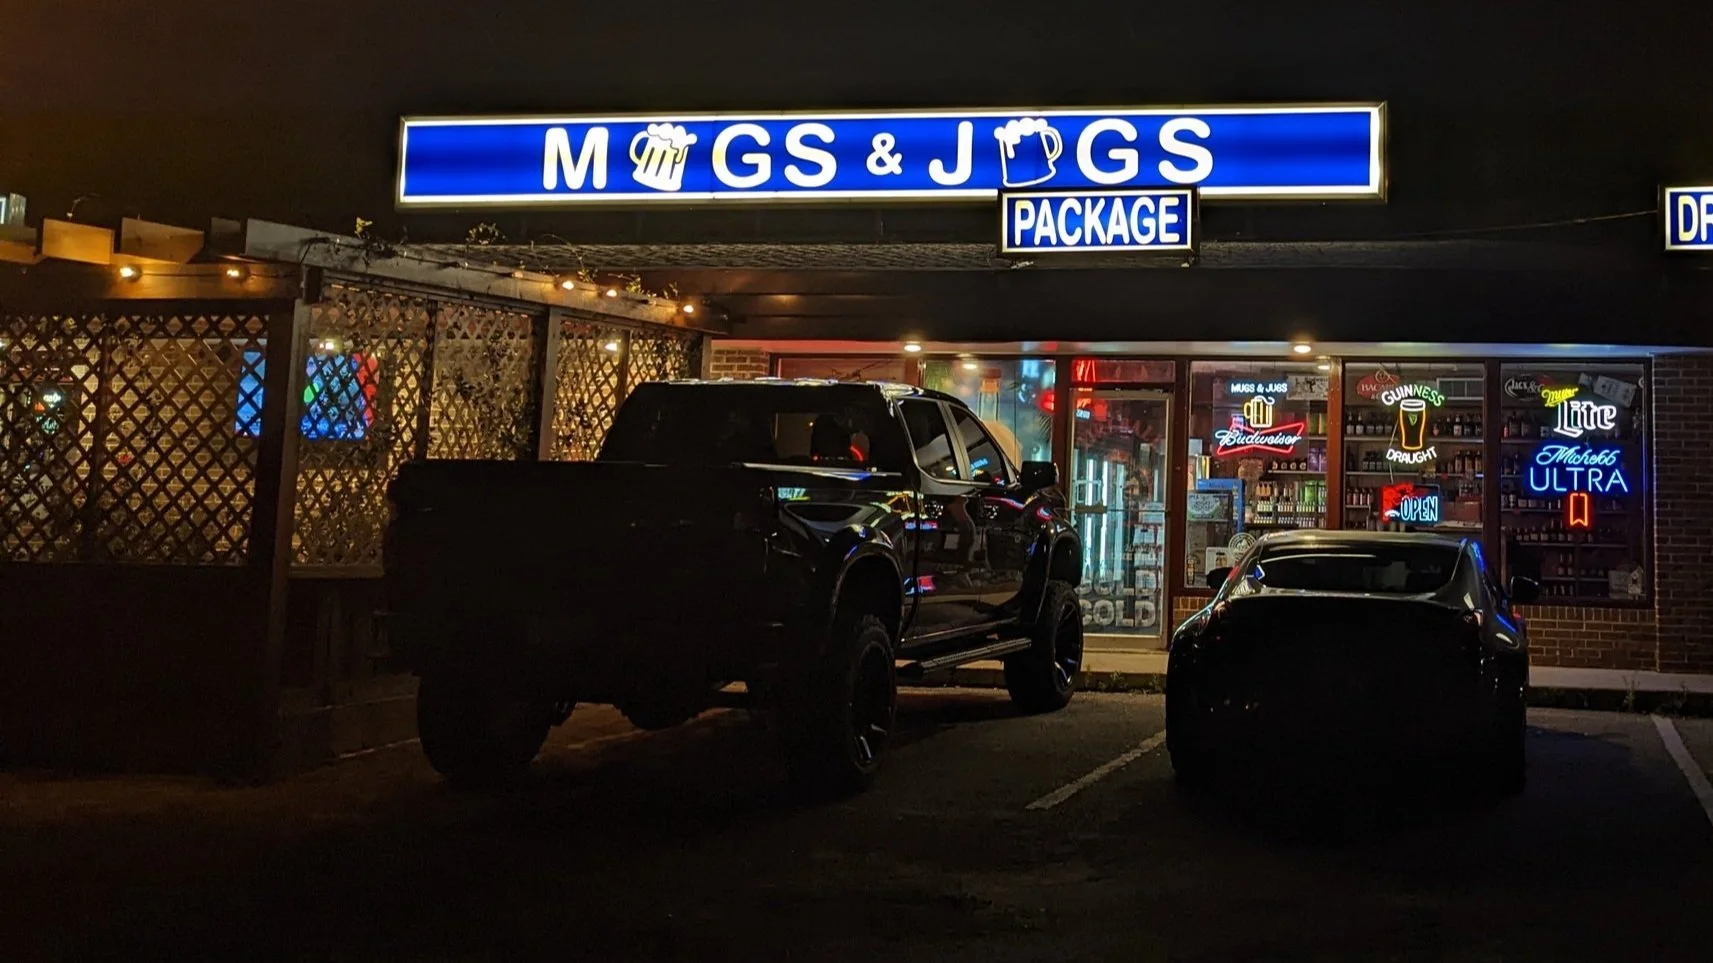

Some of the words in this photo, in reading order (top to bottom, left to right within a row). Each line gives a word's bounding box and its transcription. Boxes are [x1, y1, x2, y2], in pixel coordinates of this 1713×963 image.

[866, 132, 902, 176] &
[1014, 197, 1181, 246] PACKAGE
[1231, 383, 1255, 393] MUGS
[1256, 383, 1264, 393] &
[1265, 383, 1288, 393] JUGS
[1381, 384, 1445, 407] GUINNESS
[1553, 400, 1617, 438] Lite
[1215, 429, 1302, 446] Budweiser
[1385, 446, 1438, 465] DRAUGHT
[1530, 467, 1628, 493] ULTRA
[1400, 495, 1438, 522] OPEN
